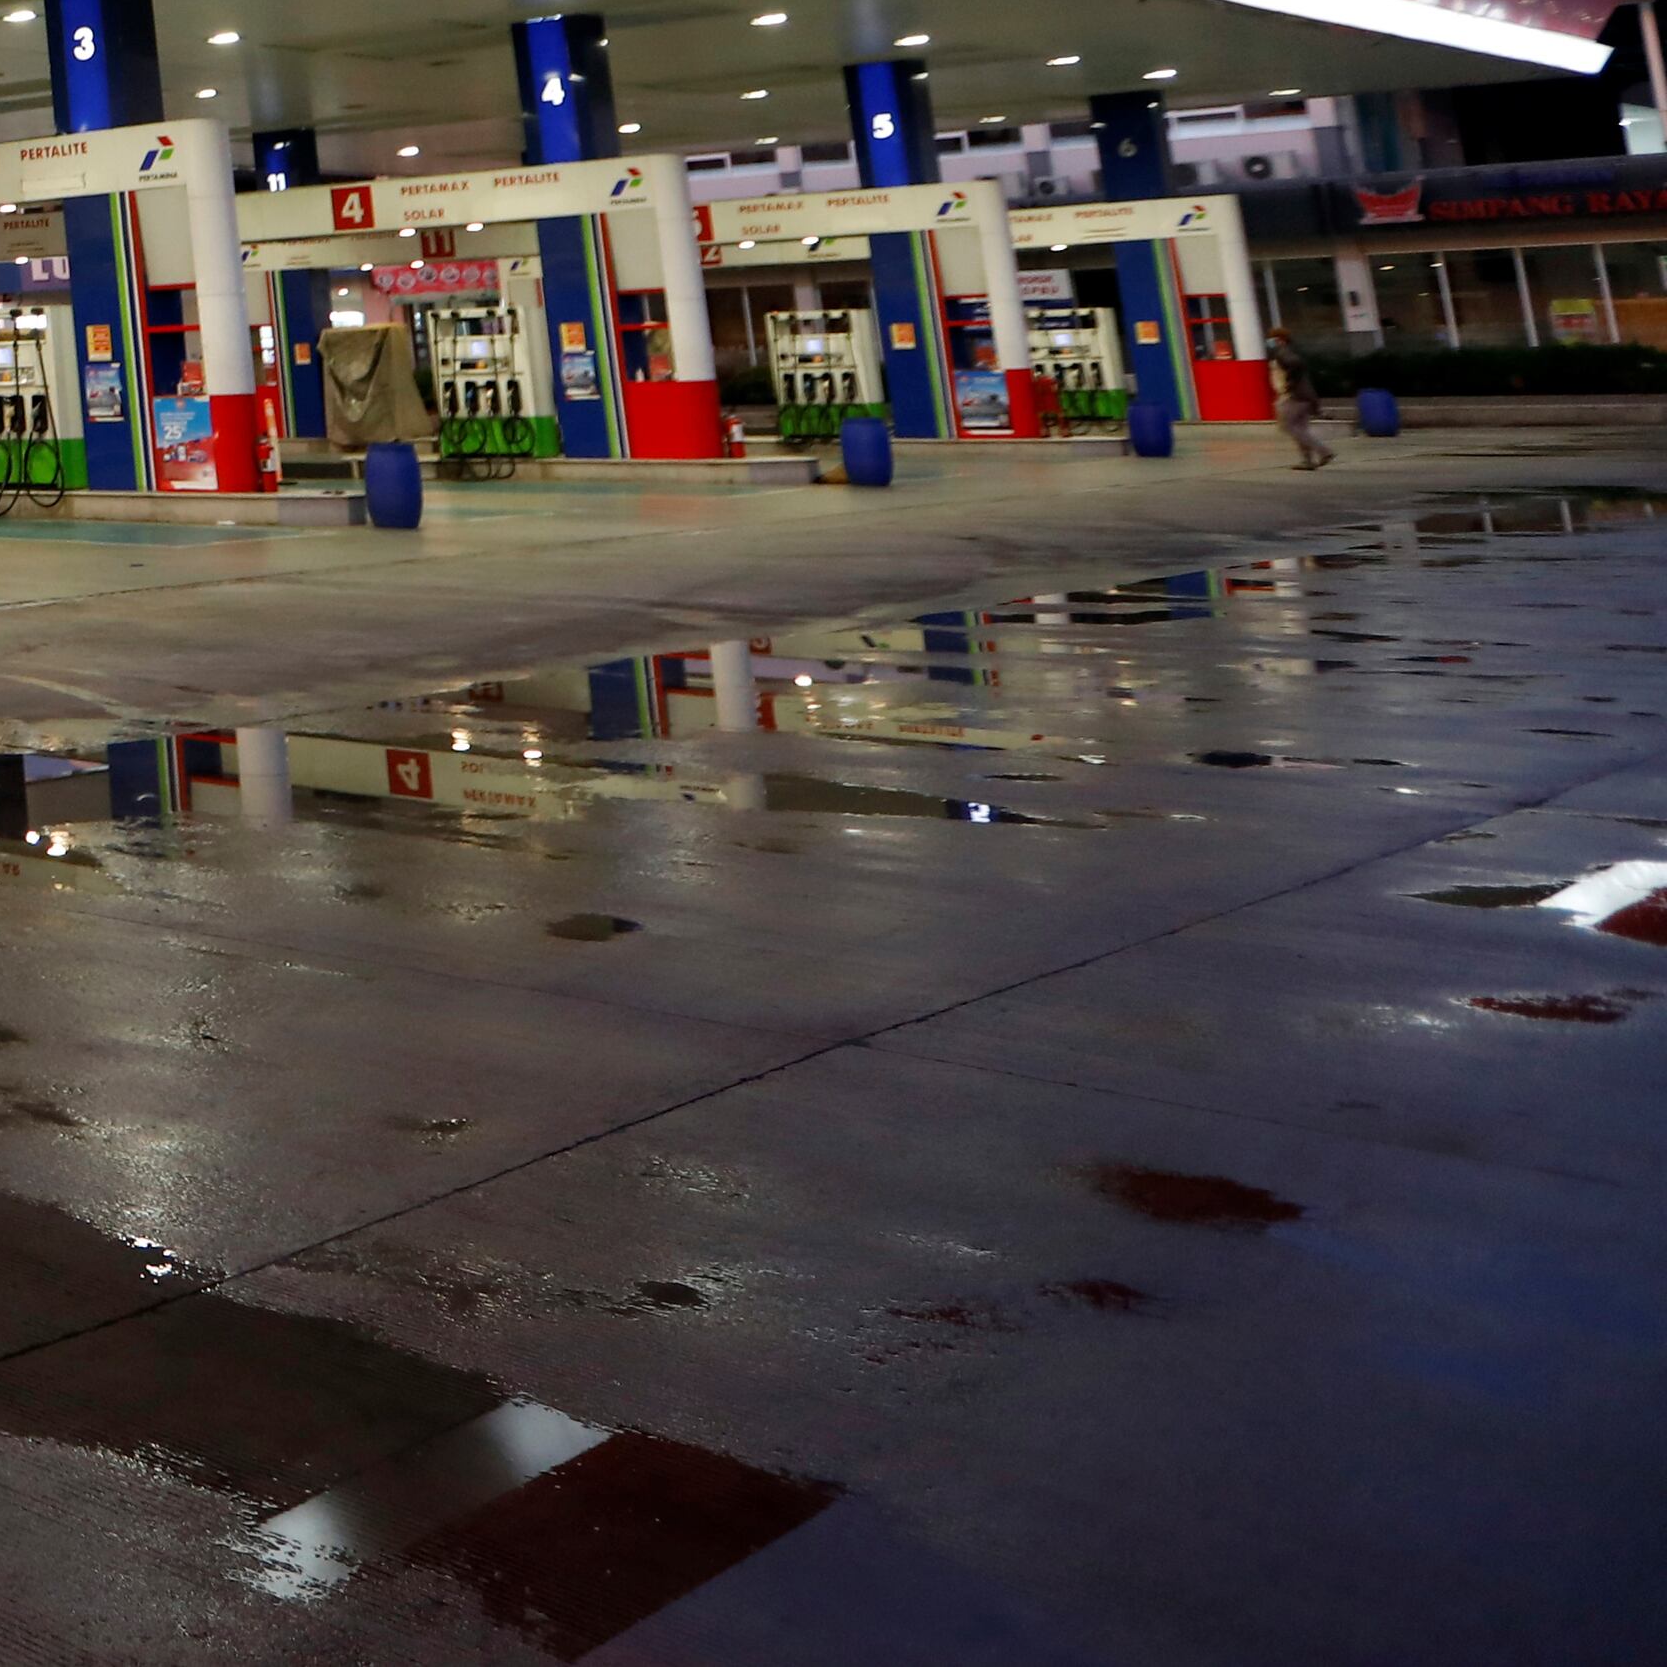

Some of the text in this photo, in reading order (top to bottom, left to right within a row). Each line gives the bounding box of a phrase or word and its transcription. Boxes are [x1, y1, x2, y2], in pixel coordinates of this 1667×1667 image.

[73, 26, 95, 61] 3
[541, 76, 565, 106] 4
[872, 113, 895, 139] 5
[20, 141, 88, 161] PERTALITE
[401, 172, 560, 196] PERTAMAX PERTALITE
[341, 193, 365, 224] 4
[404, 208, 445, 221] SOLAR
